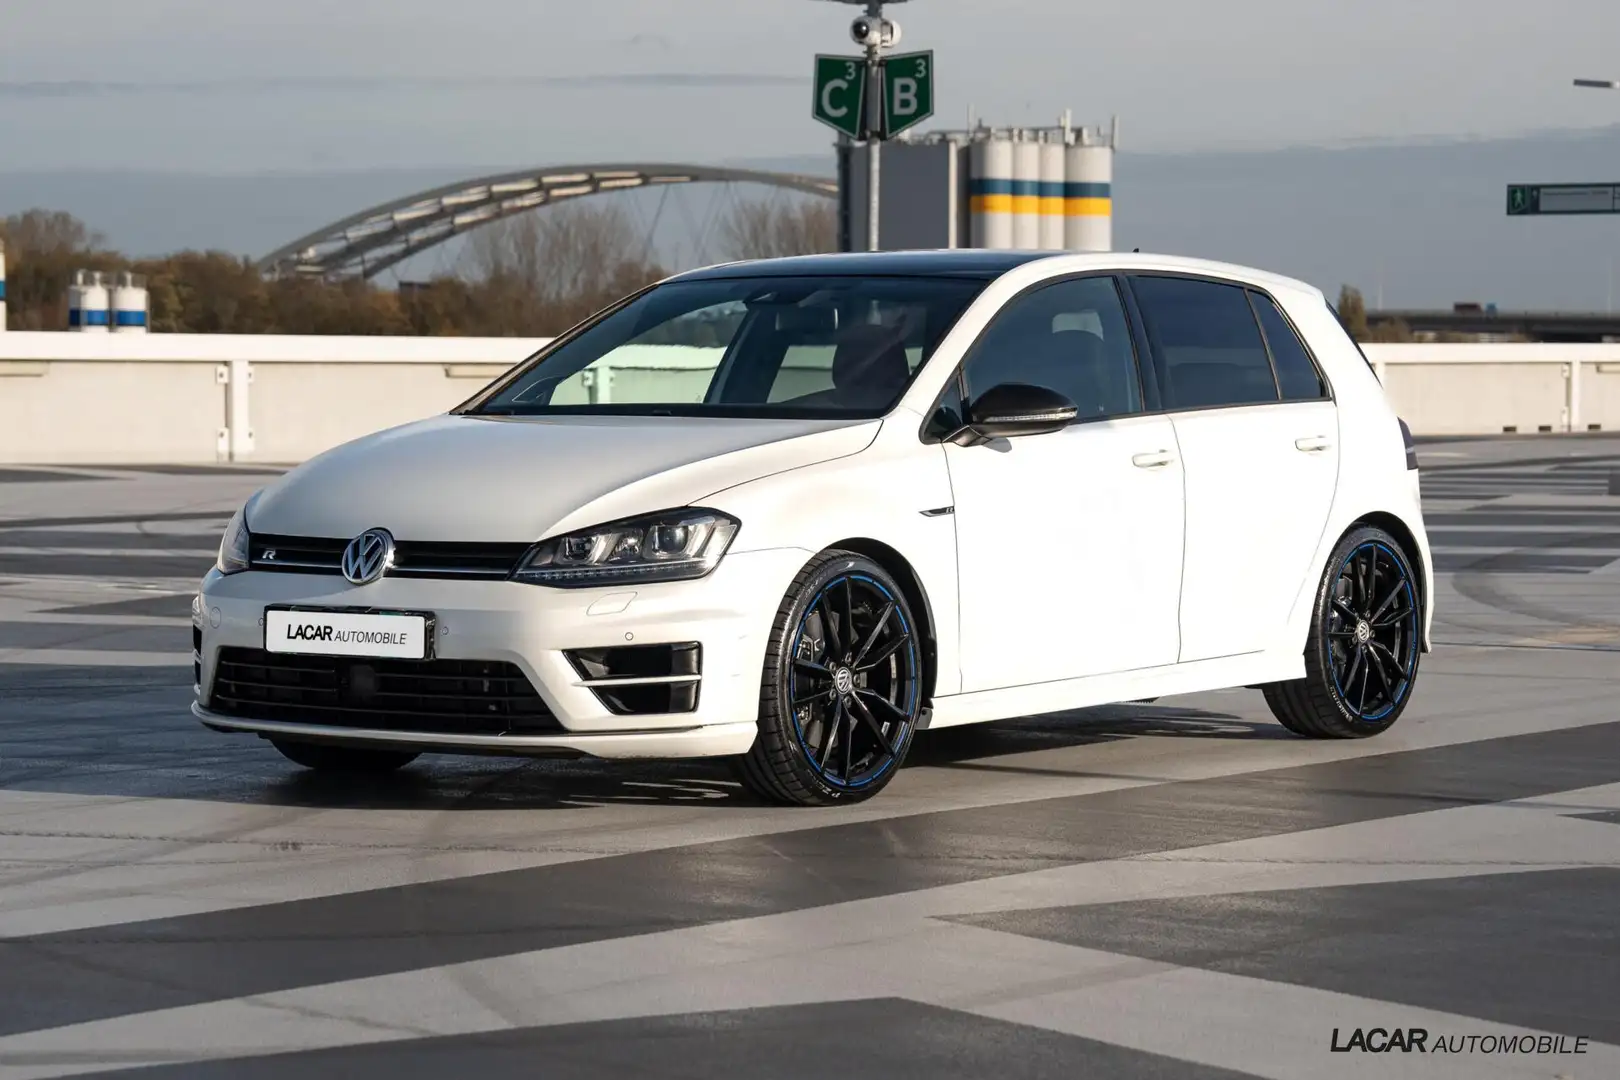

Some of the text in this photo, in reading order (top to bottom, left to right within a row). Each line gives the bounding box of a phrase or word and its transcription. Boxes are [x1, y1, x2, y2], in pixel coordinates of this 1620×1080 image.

[822, 62, 856, 118] C 3
[893, 58, 926, 116] B 3
[262, 550, 276, 560] R
[287, 624, 407, 645] LACAR AUTOMOBILE
